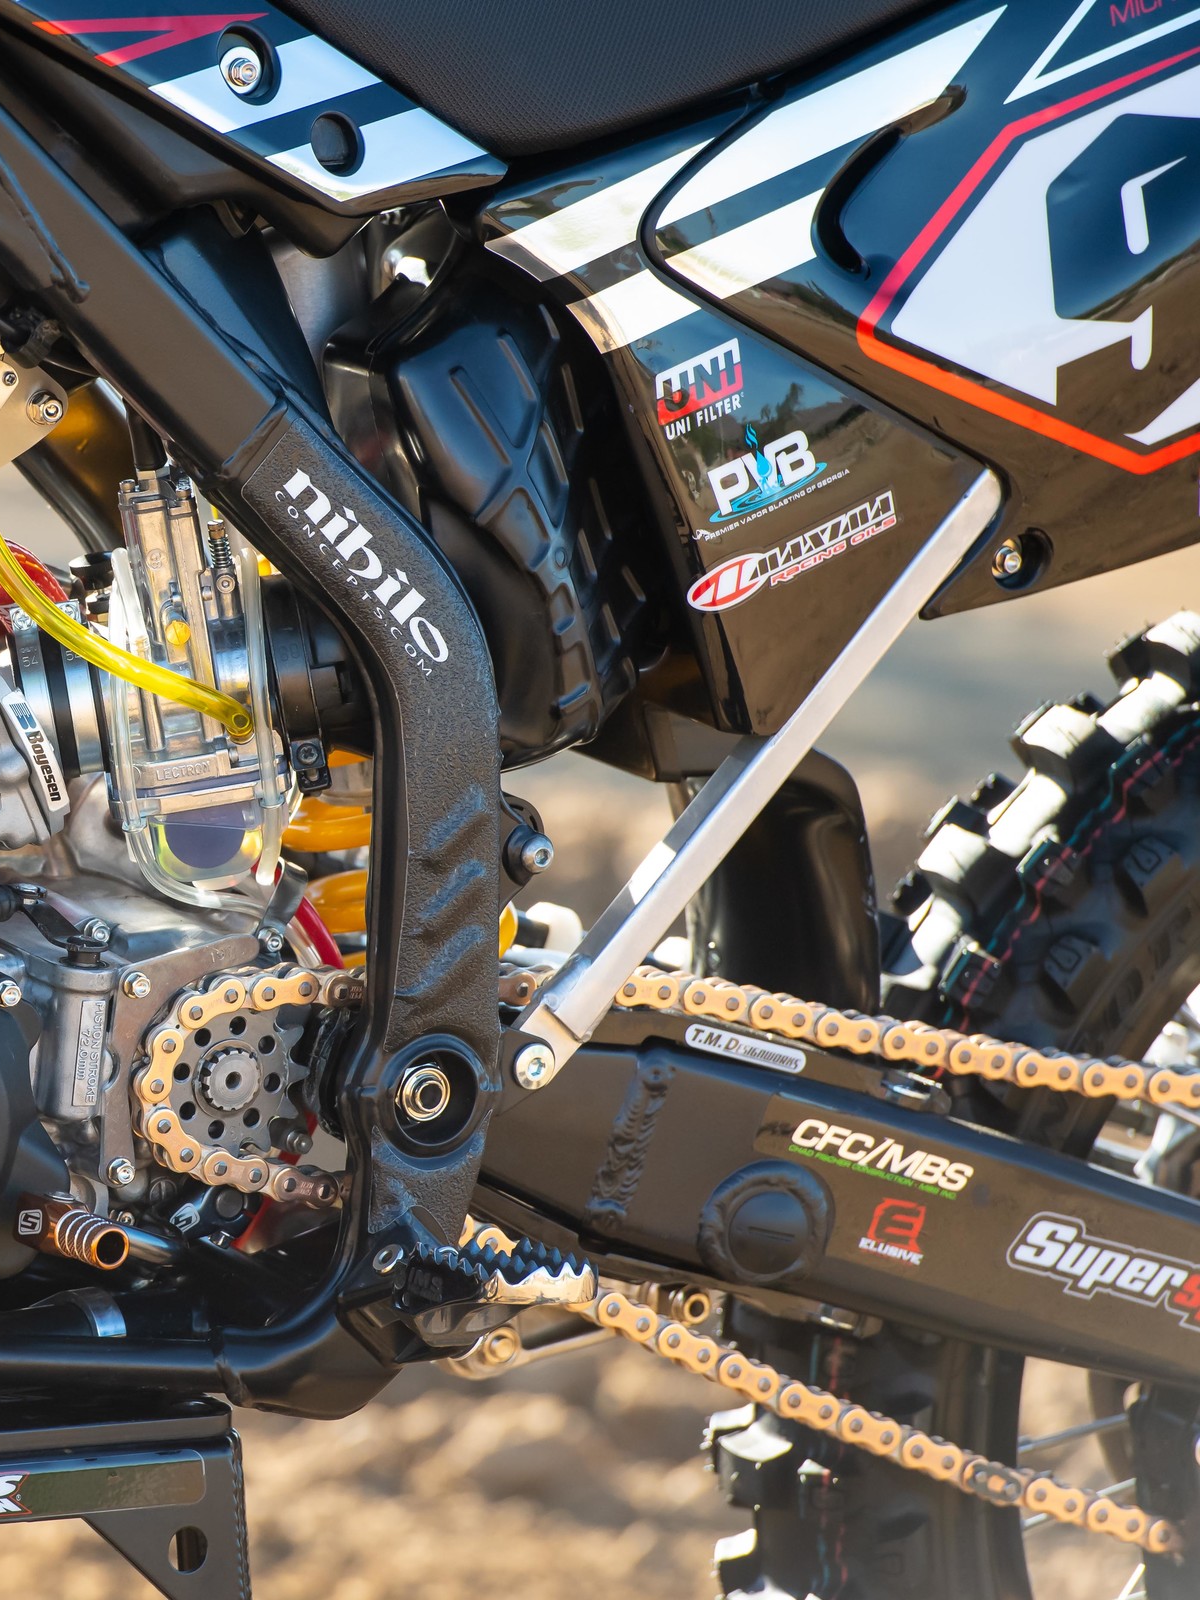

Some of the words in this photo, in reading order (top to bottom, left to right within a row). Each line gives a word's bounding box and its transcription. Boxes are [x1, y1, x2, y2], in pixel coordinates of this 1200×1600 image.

[664, 415, 691, 440] UNI
[696, 394, 742, 428] FILTER
[707, 430, 817, 516] PVB
[704, 520, 740, 542] PREMIER
[740, 508, 768, 525] VAPOR
[768, 490, 806, 513] BLASTING
[806, 484, 816, 495] OF
[817, 468, 850, 490] GEORGIA
[850, 514, 897, 546] OILS
[275, 490, 433, 677] CONCEPTS.COM
[26, 731, 62, 802] Boyesen
[155, 760, 211, 781] LECTRON
[90, 1001, 106, 1049] PISTON
[689, 1028, 723, 1048] T.M.
[76, 1028, 91, 1081] 72.0mm
[84, 1052, 100, 1104] STROKE
[791, 1118, 974, 1192] CFC/MBS
[859, 1237, 924, 1266] ELUSIVE
